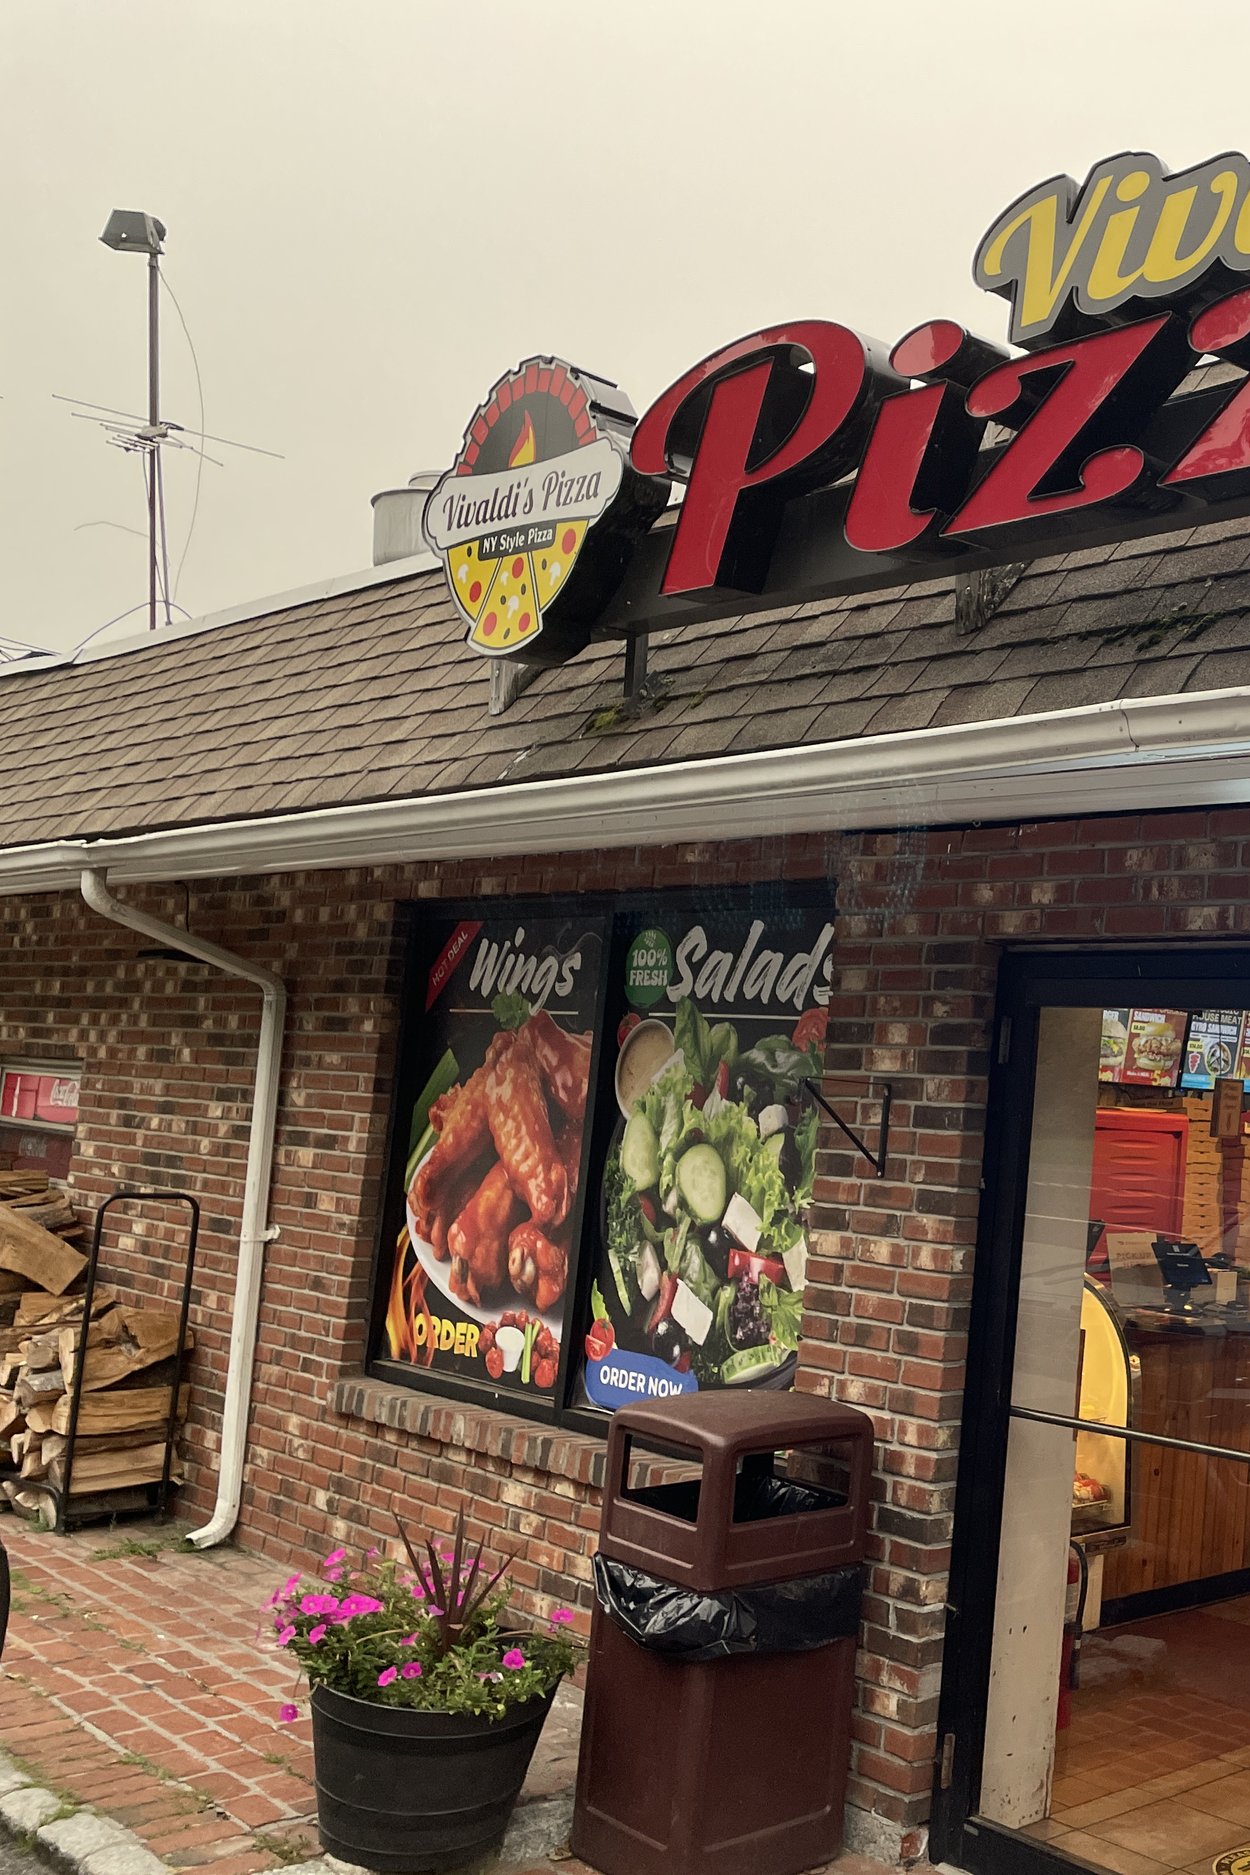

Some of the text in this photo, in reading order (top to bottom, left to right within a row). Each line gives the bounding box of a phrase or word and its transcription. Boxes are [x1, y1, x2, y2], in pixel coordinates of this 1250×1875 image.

[442, 469, 602, 531] Vivaldi's Pizza
[482, 527, 553, 554] NY Style Pizza
[432, 931, 468, 987] HOT DEAL
[469, 925, 582, 1016] Wings
[632, 948, 668, 967] 100%
[629, 969, 668, 986] FRESH
[1220, 1014, 1242, 1025] MEAT
[415, 1312, 480, 1358] ORDER
[600, 1365, 683, 1398] ORDER NOW
